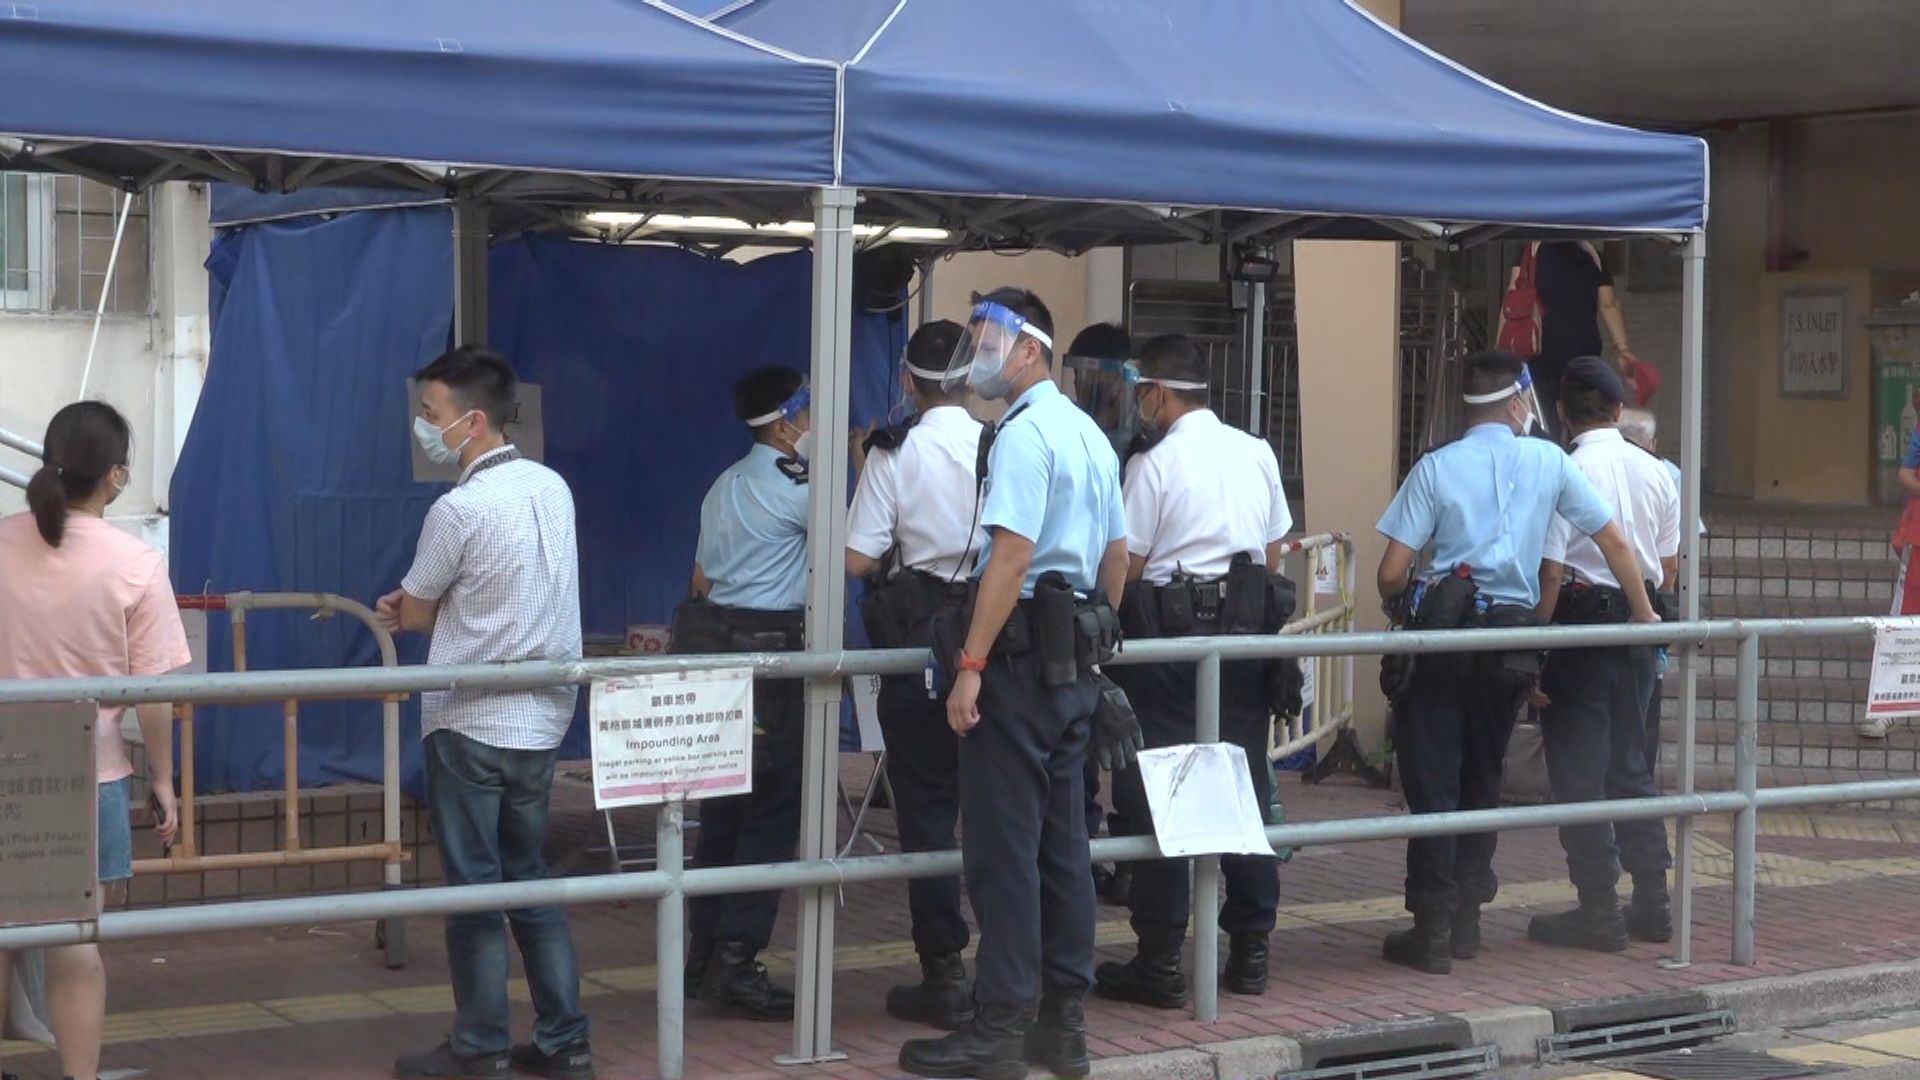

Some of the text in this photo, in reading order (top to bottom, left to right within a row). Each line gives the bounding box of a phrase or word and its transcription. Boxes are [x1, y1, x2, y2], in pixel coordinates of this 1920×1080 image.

[1807, 312, 1840, 333] INLET
[626, 733, 720, 751] Impounding Area
[623, 757, 652, 767] parking
[663, 754, 685, 764] yellow
